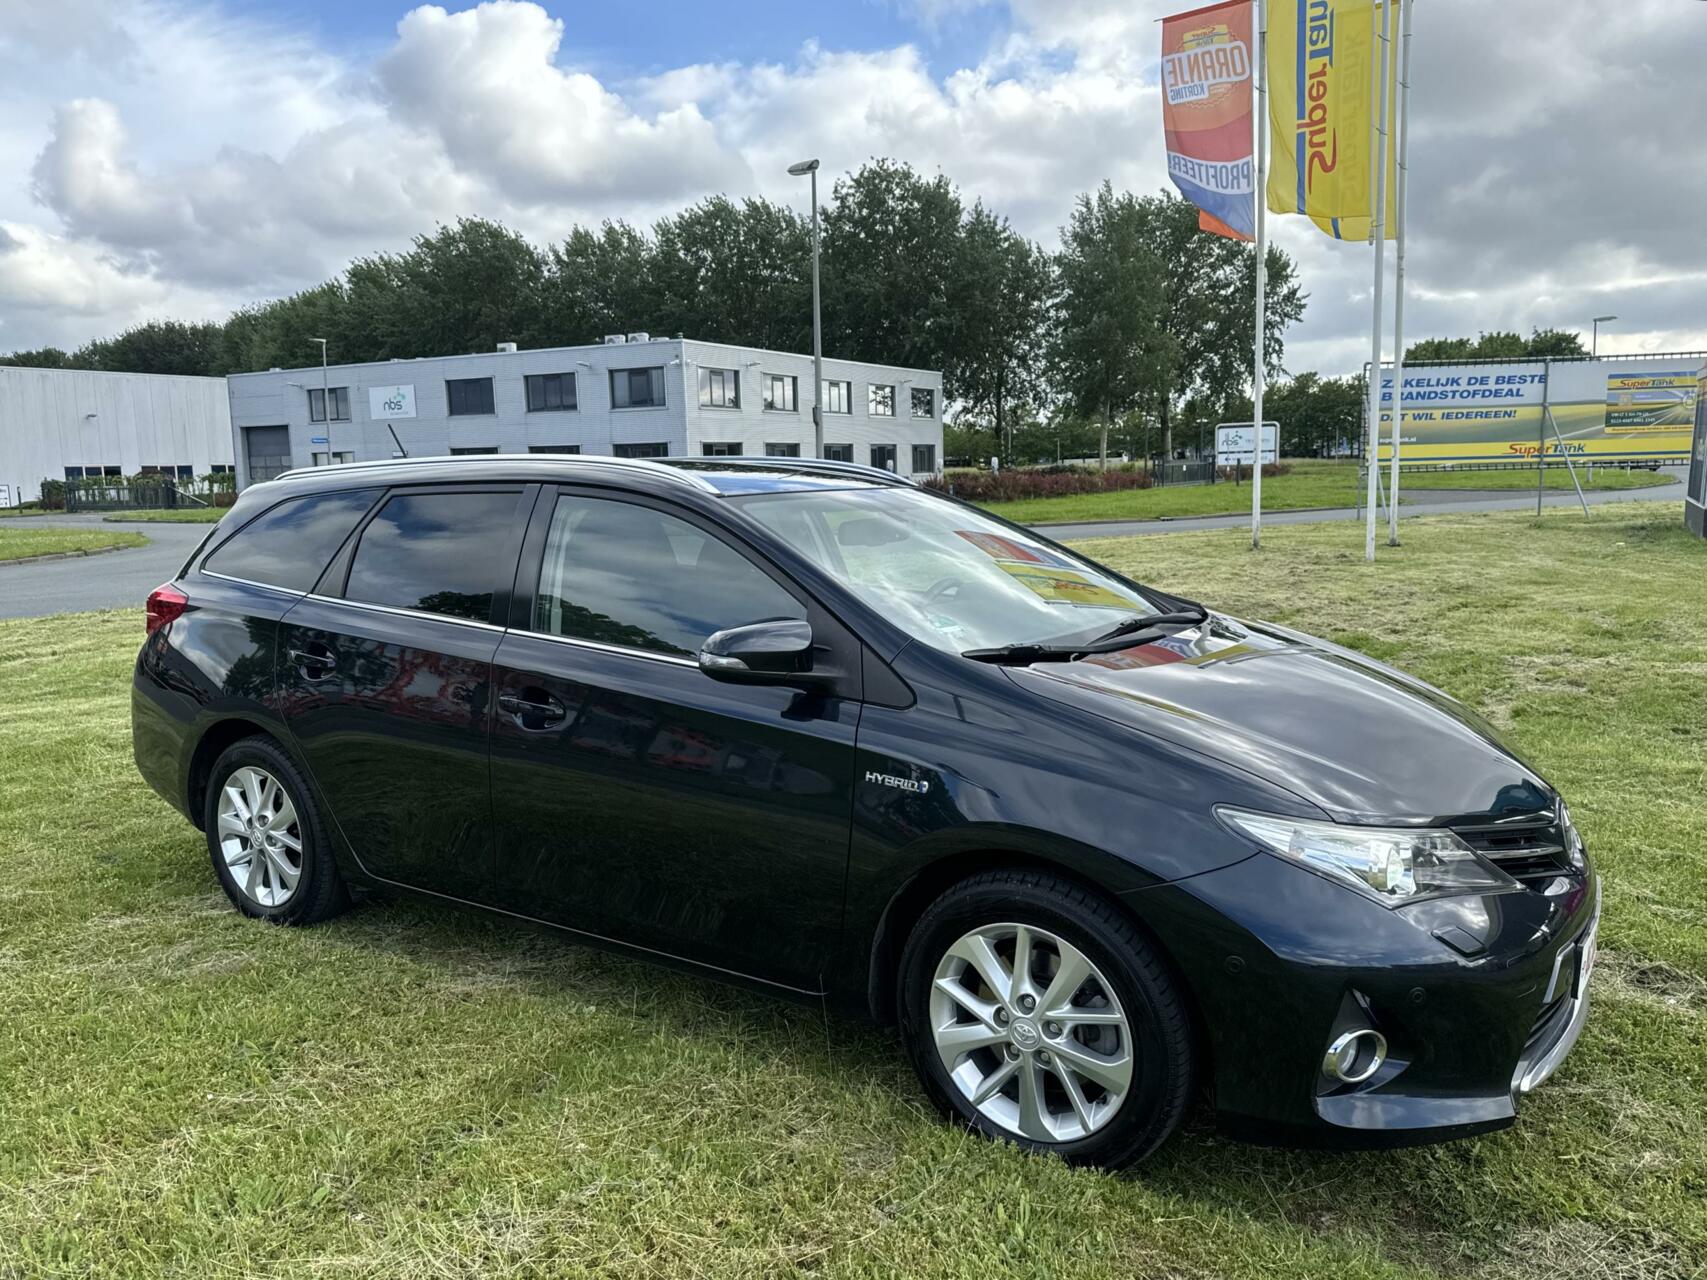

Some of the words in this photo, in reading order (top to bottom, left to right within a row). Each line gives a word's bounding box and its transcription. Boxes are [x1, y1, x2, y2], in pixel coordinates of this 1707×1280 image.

[1381, 377, 1462, 389] ZKELIJK
[1467, 375, 1490, 387] DE
[1494, 374, 1547, 386] BESTE
[383, 398, 403, 411] nbs
[1380, 413, 1408, 422] DT
[1412, 412, 1437, 421] WIL
[1441, 410, 1517, 420] IEDEREEN!
[865, 771, 918, 792] HYBRID
